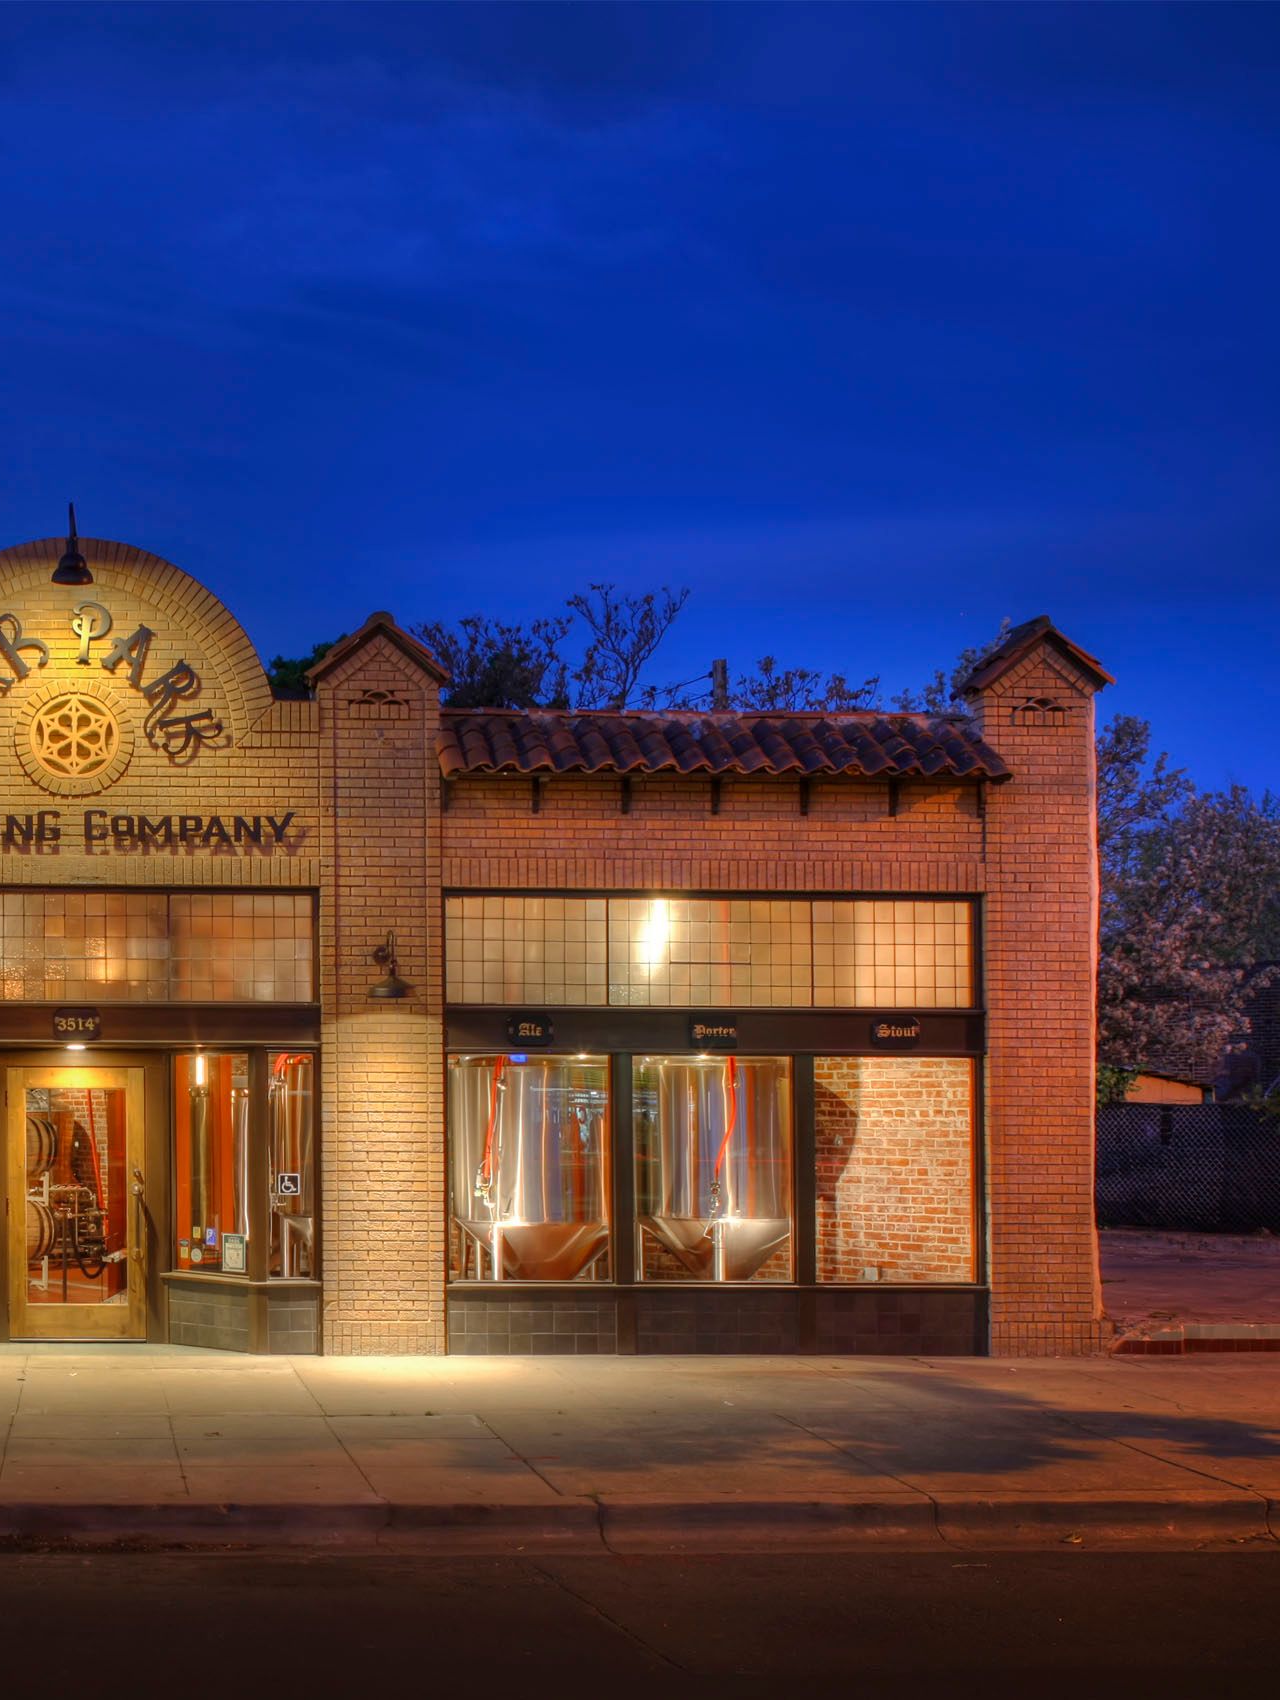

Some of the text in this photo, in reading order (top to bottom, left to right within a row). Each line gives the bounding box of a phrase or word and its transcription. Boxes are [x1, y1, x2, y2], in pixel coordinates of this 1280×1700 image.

[72, 600, 223, 756] PARK
[84, 808, 297, 844] COMPANY
[57, 1017, 95, 1031] 3514
[693, 1024, 735, 1039] Porter
[876, 1023, 917, 1038] Stout
